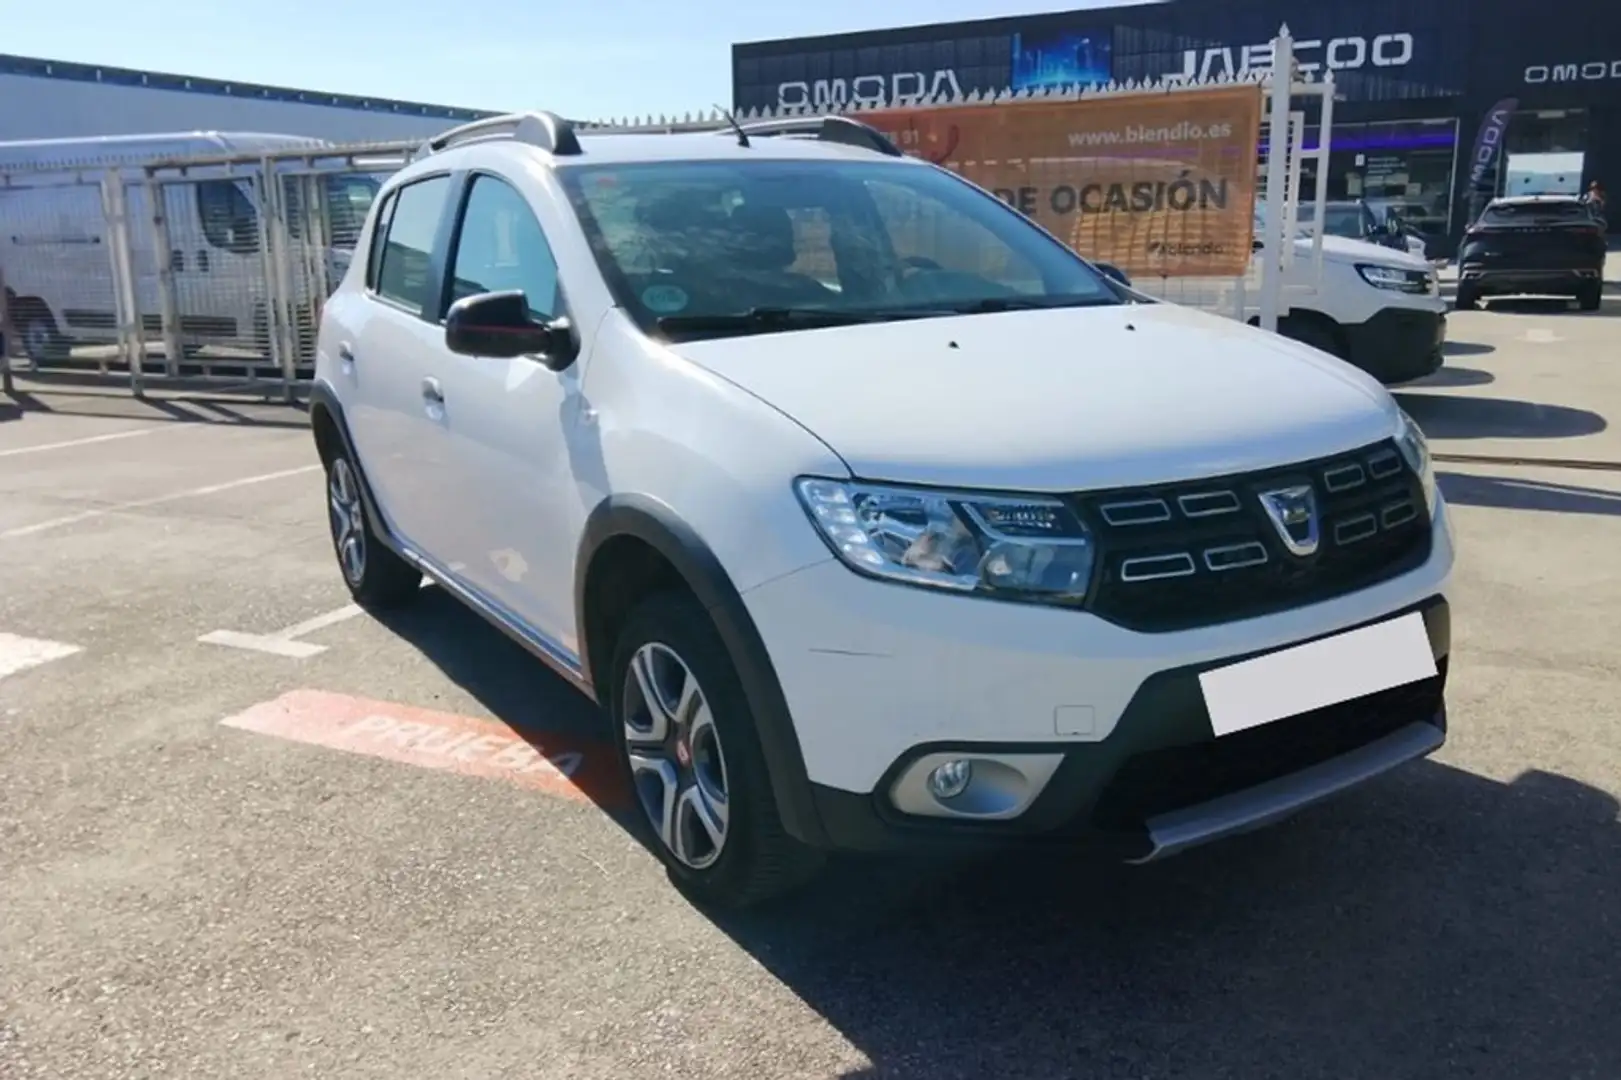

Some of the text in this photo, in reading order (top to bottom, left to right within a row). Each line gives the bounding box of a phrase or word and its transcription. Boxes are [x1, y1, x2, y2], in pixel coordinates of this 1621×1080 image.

[779, 69, 963, 108] OMODA
[1068, 121, 1233, 147] www.blendio.es
[1050, 169, 1228, 214] OCASIÓN
